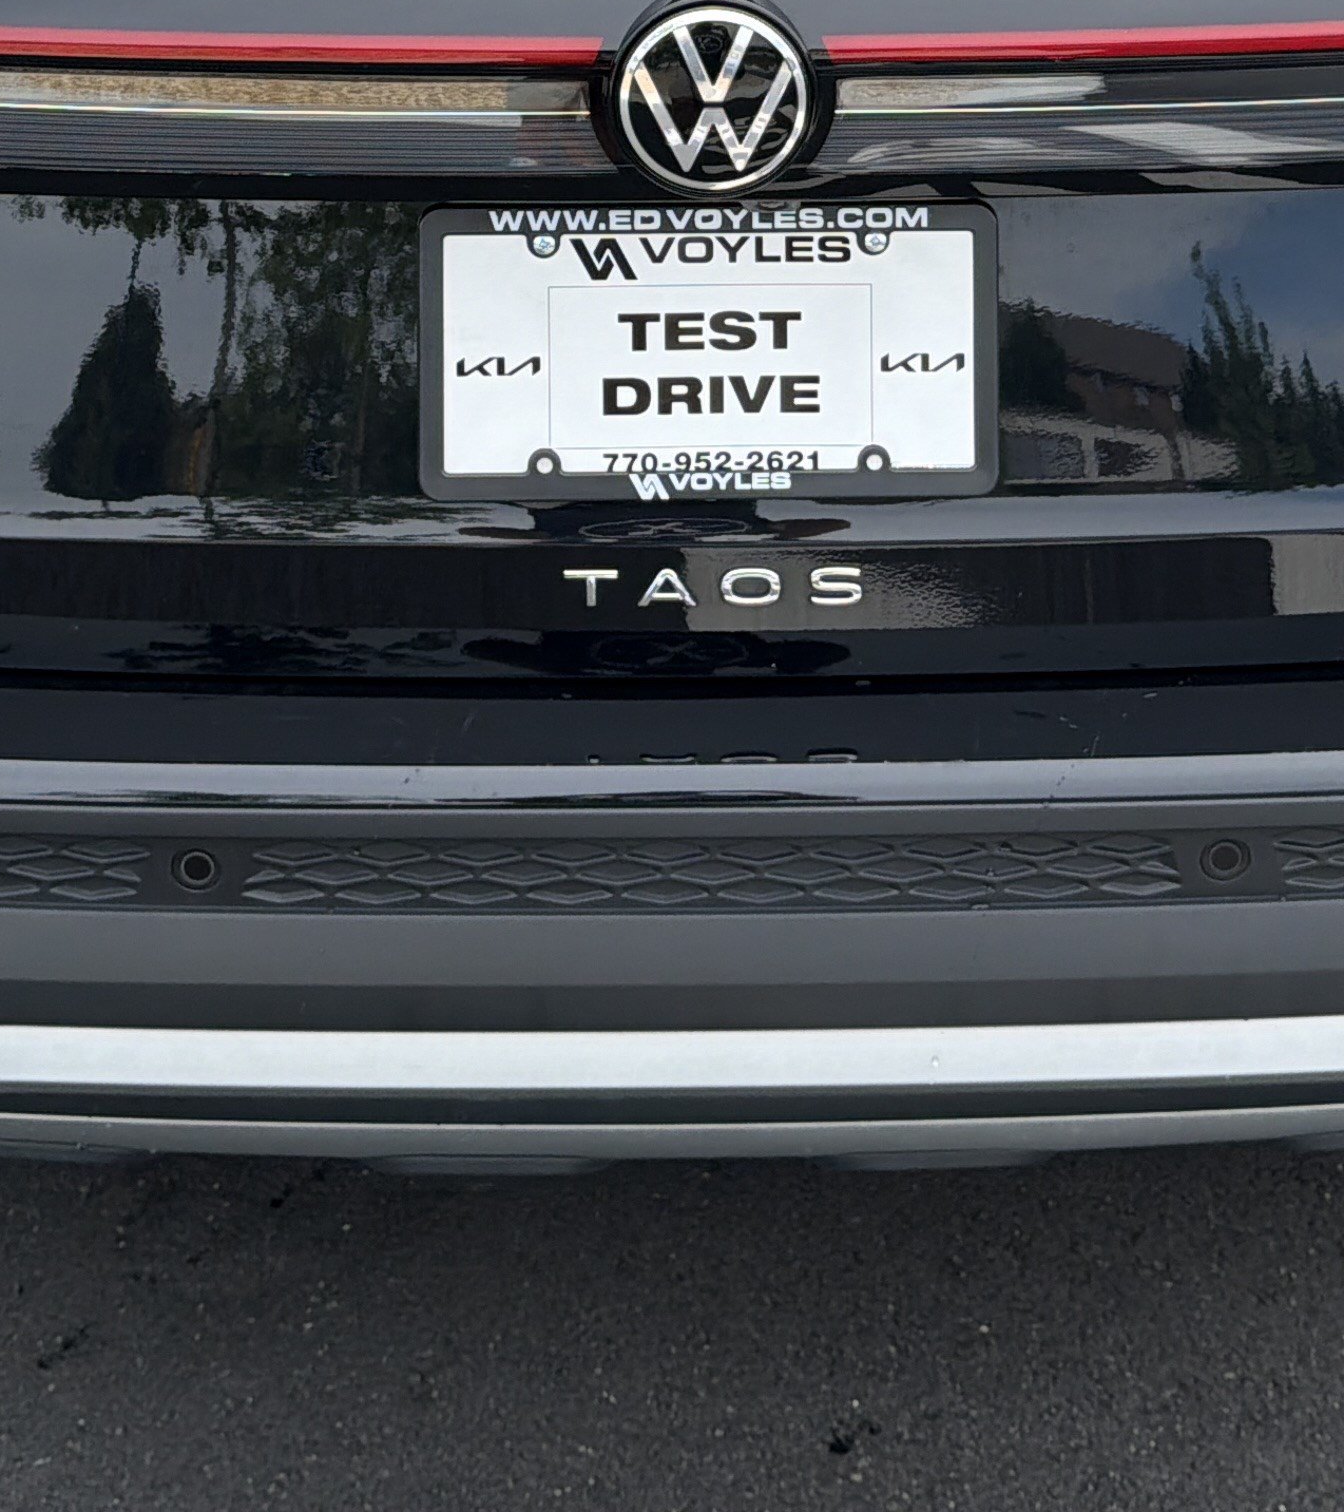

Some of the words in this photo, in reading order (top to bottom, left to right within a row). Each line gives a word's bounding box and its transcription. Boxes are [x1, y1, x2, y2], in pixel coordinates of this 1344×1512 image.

[639, 236, 851, 264] VOYLES
[618, 311, 802, 352] TEST
[602, 375, 821, 416] DRIVE
[602, 450, 820, 474] 770-952-2621
[669, 472, 792, 491] VOYLES
[563, 567, 863, 607] TAOS
